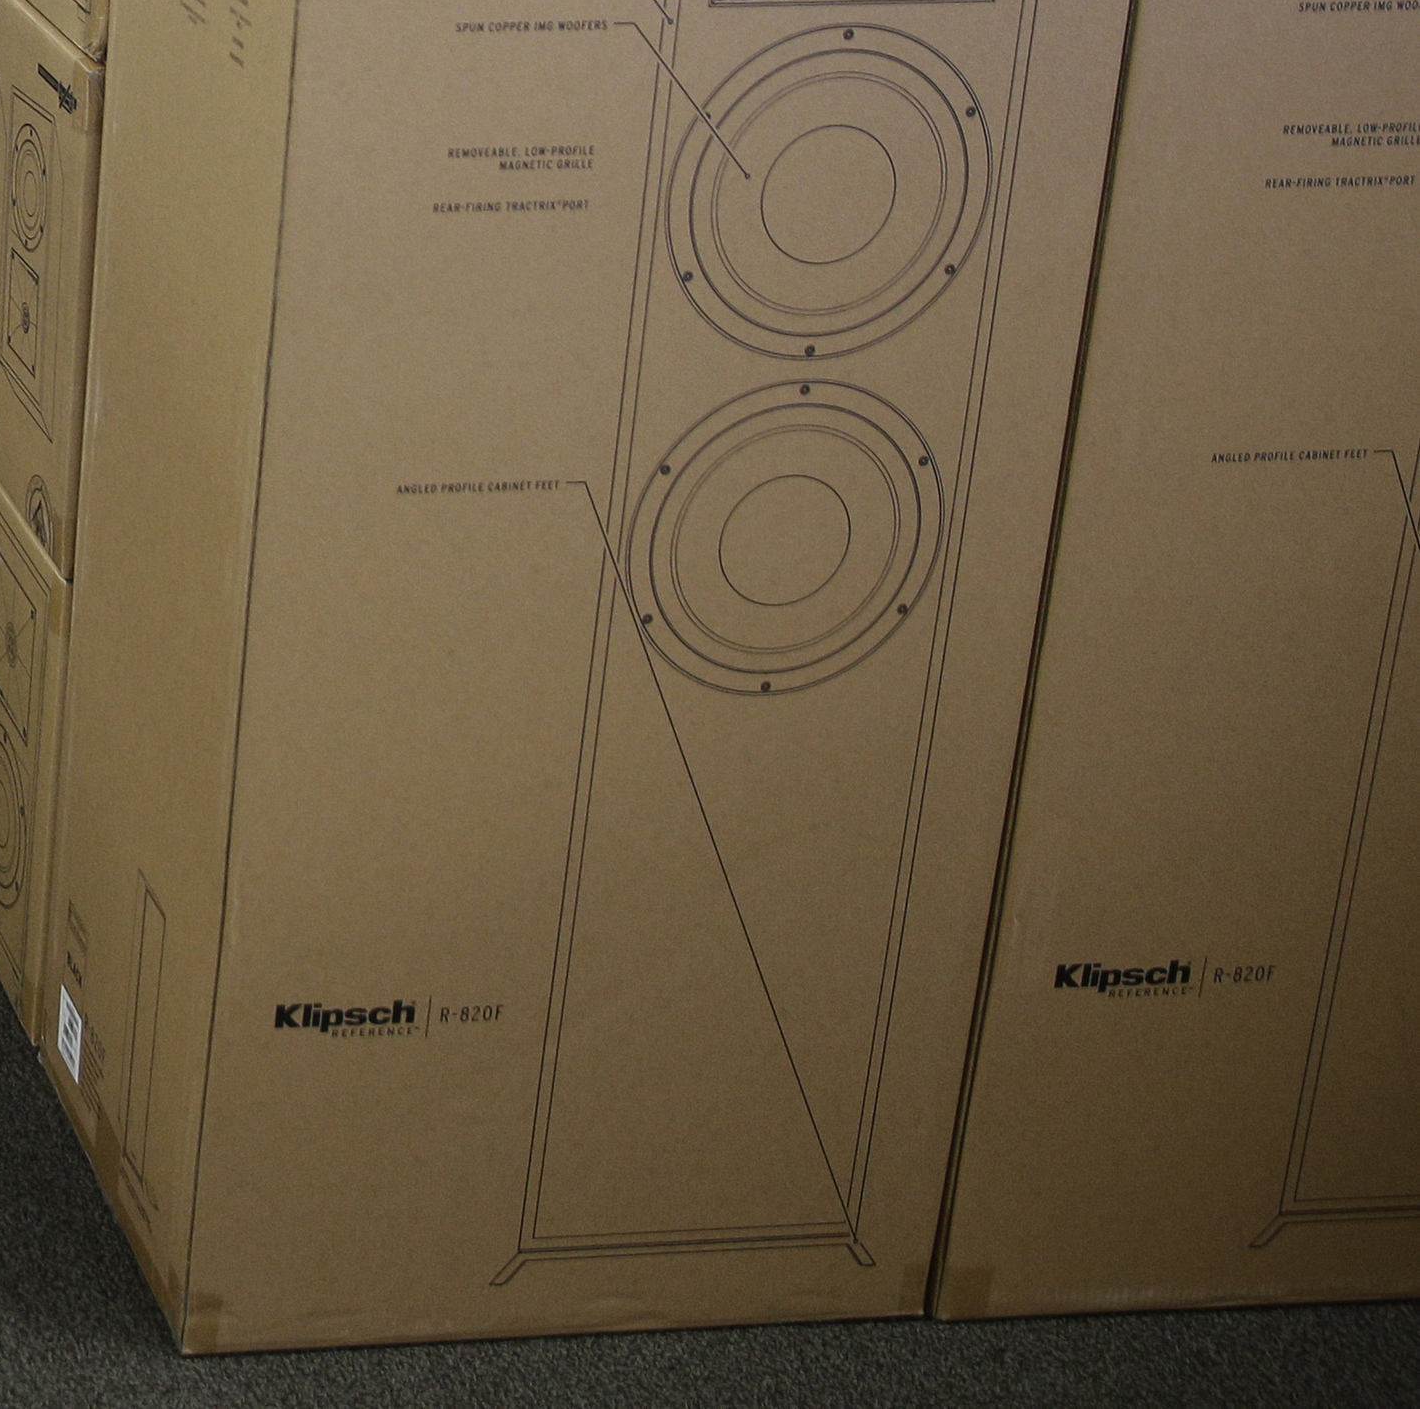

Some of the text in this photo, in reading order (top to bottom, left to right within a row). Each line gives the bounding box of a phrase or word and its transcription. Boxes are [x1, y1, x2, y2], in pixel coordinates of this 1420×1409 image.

[1299, 0, 1370, 13] SPUN COPPER
[455, 19, 608, 33] SPUN COPPER WOOFERS
[1331, 136, 1383, 148] MAGNETIC
[525, 145, 595, 157] LOW-PROFILE
[499, 159, 593, 171] MAGNETIC GRILLE
[1265, 177, 1332, 189] REAR-FIRING
[432, 199, 589, 213] REAR-FIRING PORT
[1211, 448, 1368, 463] ANGLED PROFILE CABINET FEET
[396, 481, 531, 495] ANGLED PROFILE CABINET
[1054, 959, 1277, 993] Klipsch R-820F
[274, 999, 505, 1033] Klipsch R-820F
[331, 1026, 413, 1038] REFERENCE
